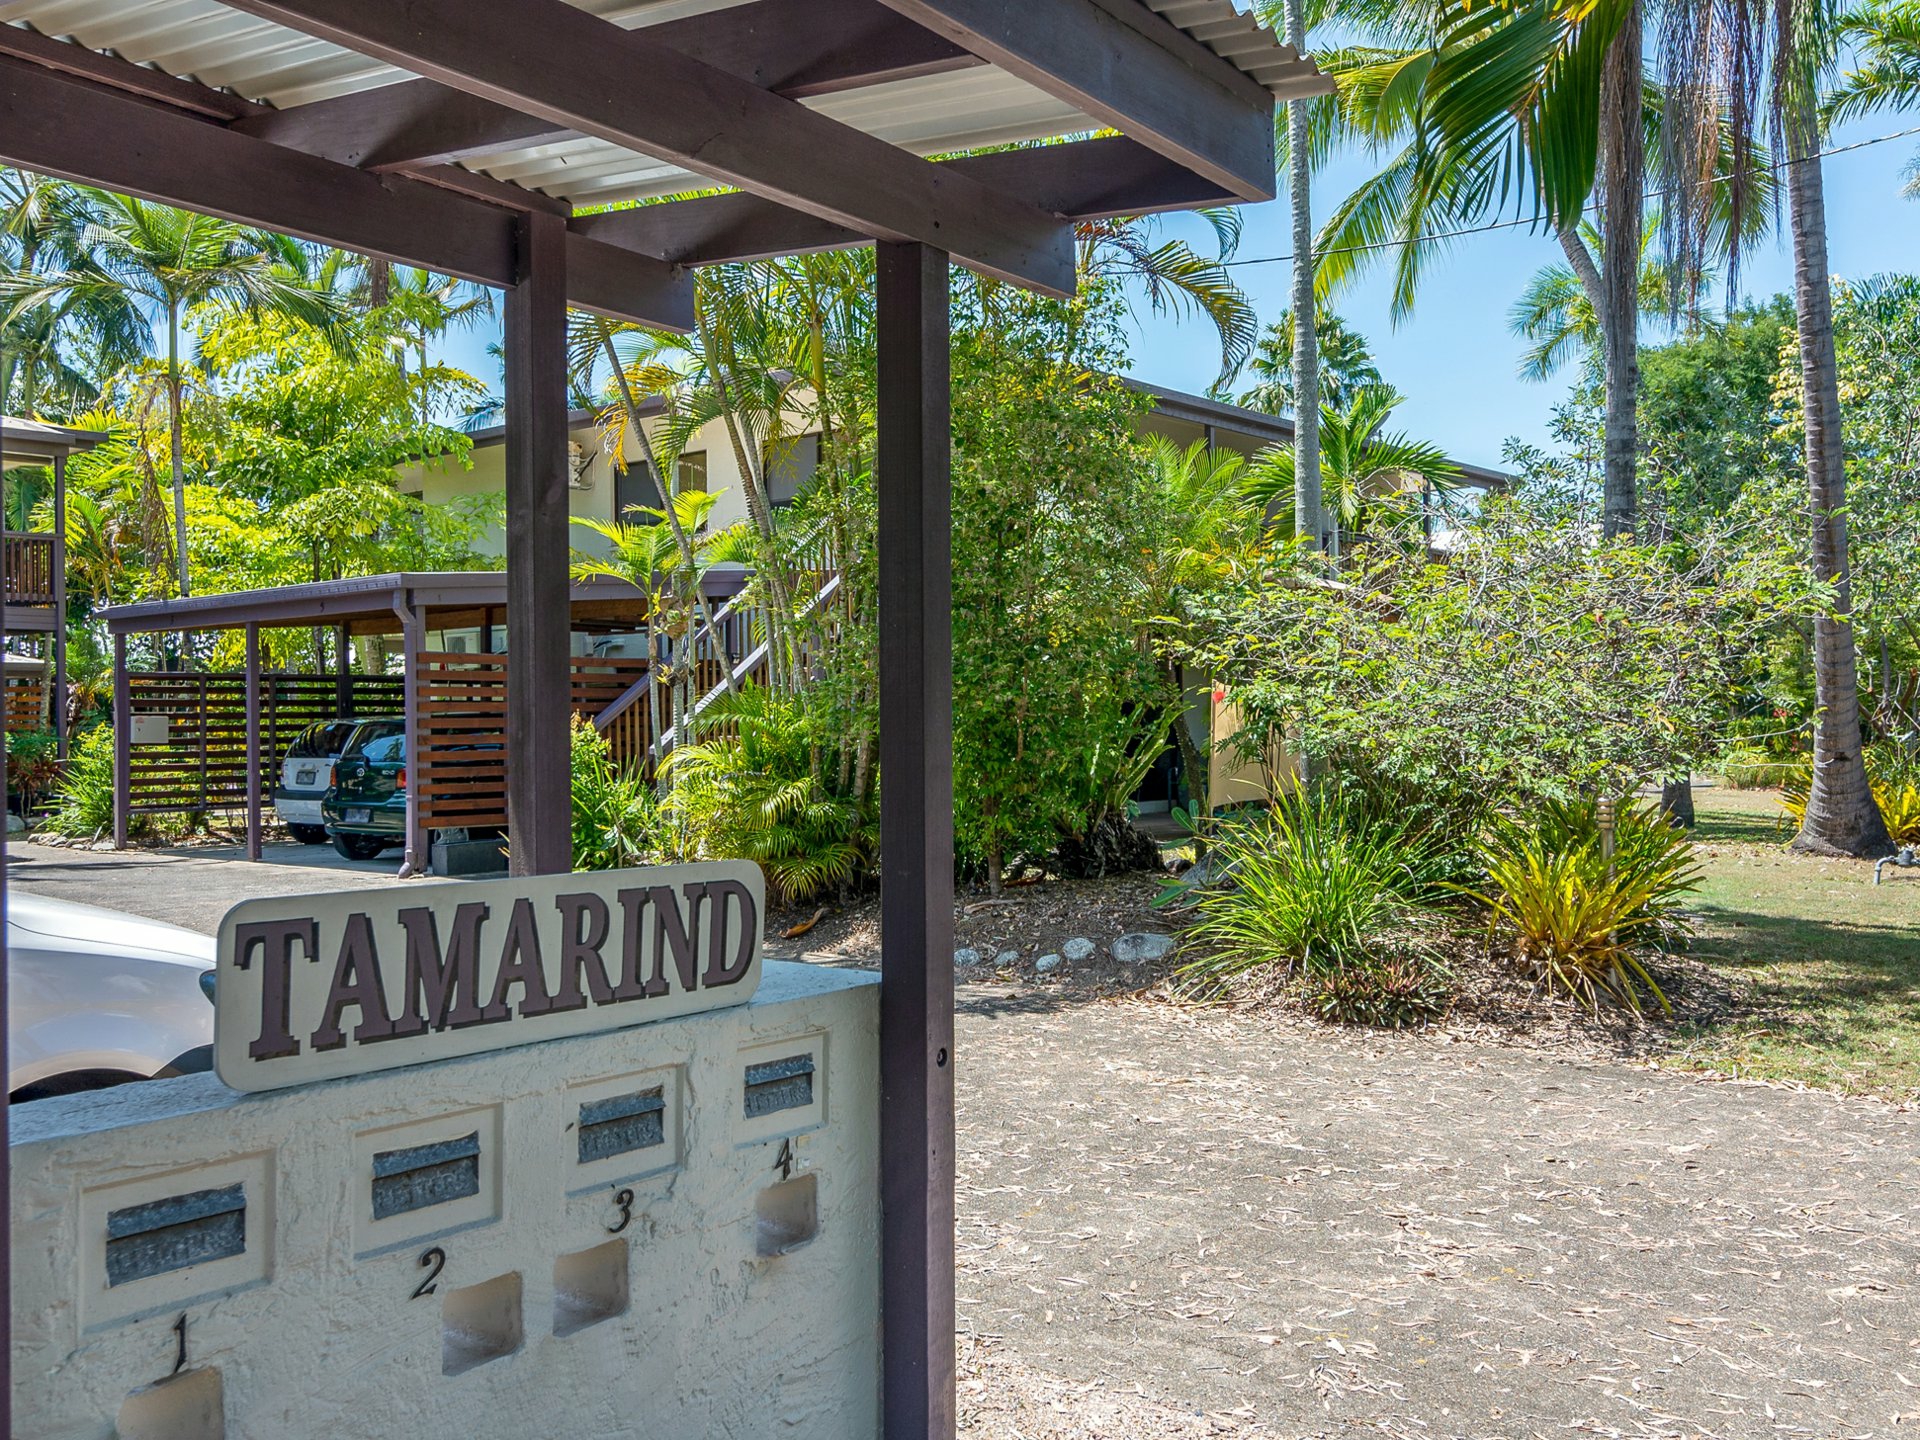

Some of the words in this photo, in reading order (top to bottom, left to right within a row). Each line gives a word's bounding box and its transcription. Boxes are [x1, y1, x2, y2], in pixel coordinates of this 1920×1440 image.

[233, 879, 757, 1062] TAMARIND
[774, 1137, 793, 1181] 4
[608, 1188, 634, 1233] 3
[410, 1246, 446, 1300] 2
[173, 1312, 187, 1374] 1
